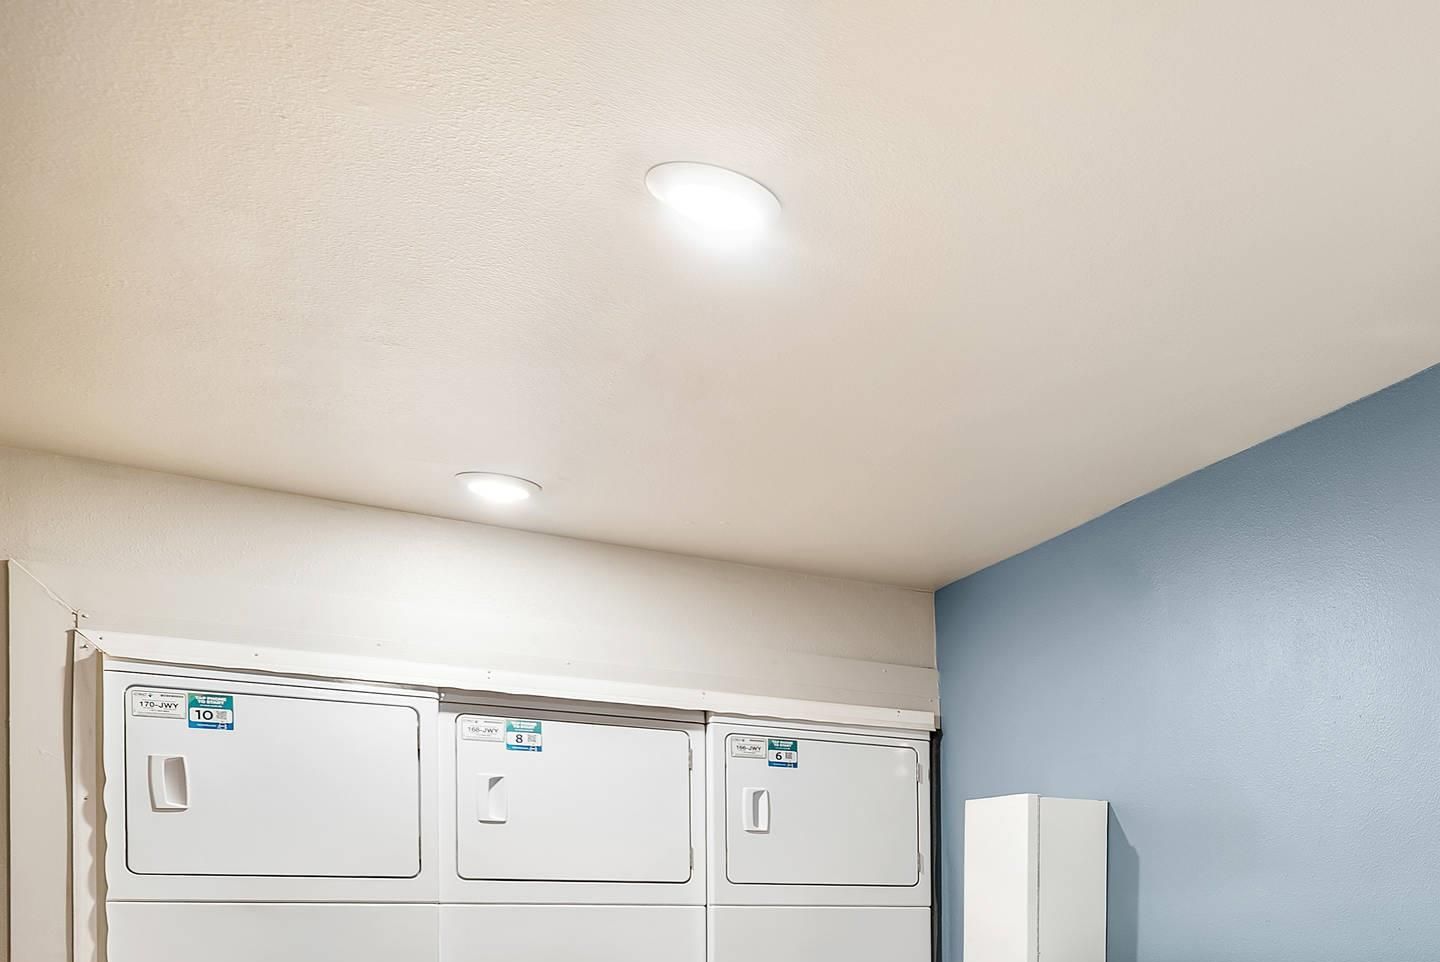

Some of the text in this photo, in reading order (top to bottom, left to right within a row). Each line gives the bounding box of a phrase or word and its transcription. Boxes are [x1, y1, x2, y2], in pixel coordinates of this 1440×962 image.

[140, 701, 179, 709] 170-JWY
[195, 710, 213, 720] 10
[515, 734, 523, 743] 8
[775, 752, 783, 760] 6
